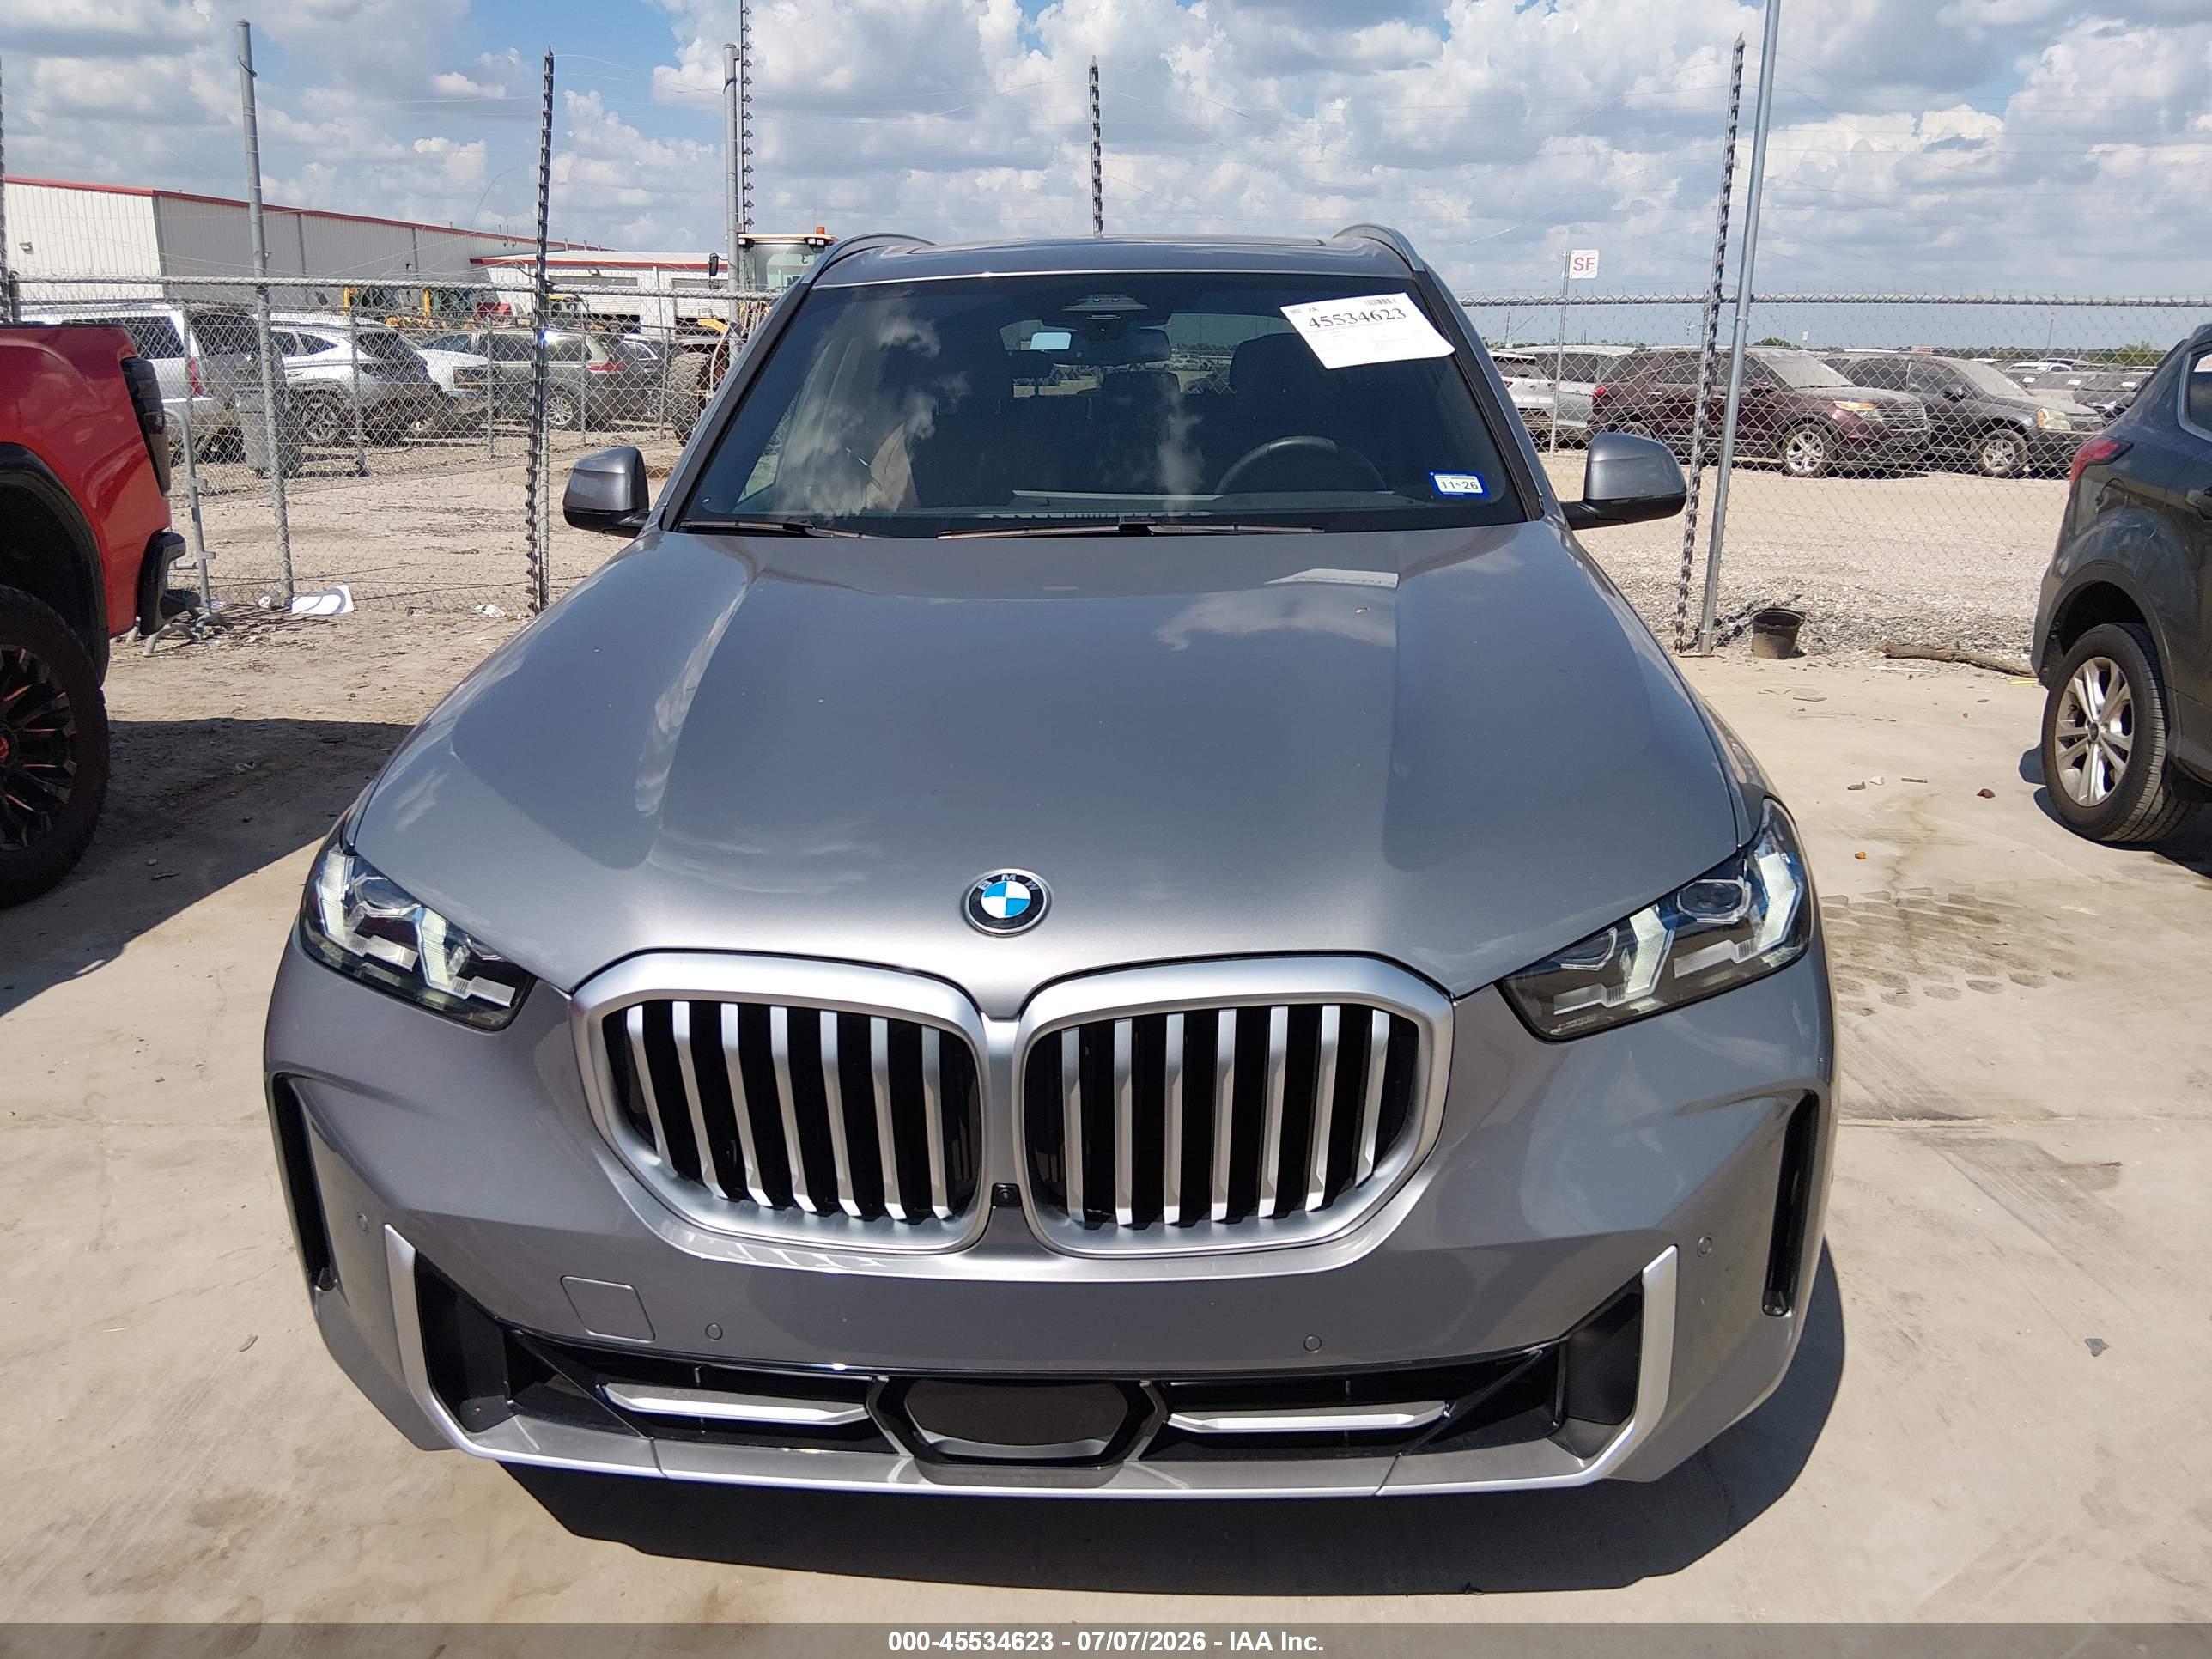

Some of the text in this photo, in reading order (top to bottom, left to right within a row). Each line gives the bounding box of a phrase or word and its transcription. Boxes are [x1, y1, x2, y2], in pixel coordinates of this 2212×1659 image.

[1573, 257, 1595, 271] SF
[1309, 307, 1407, 328] 45534623
[977, 873, 1039, 890] BMW
